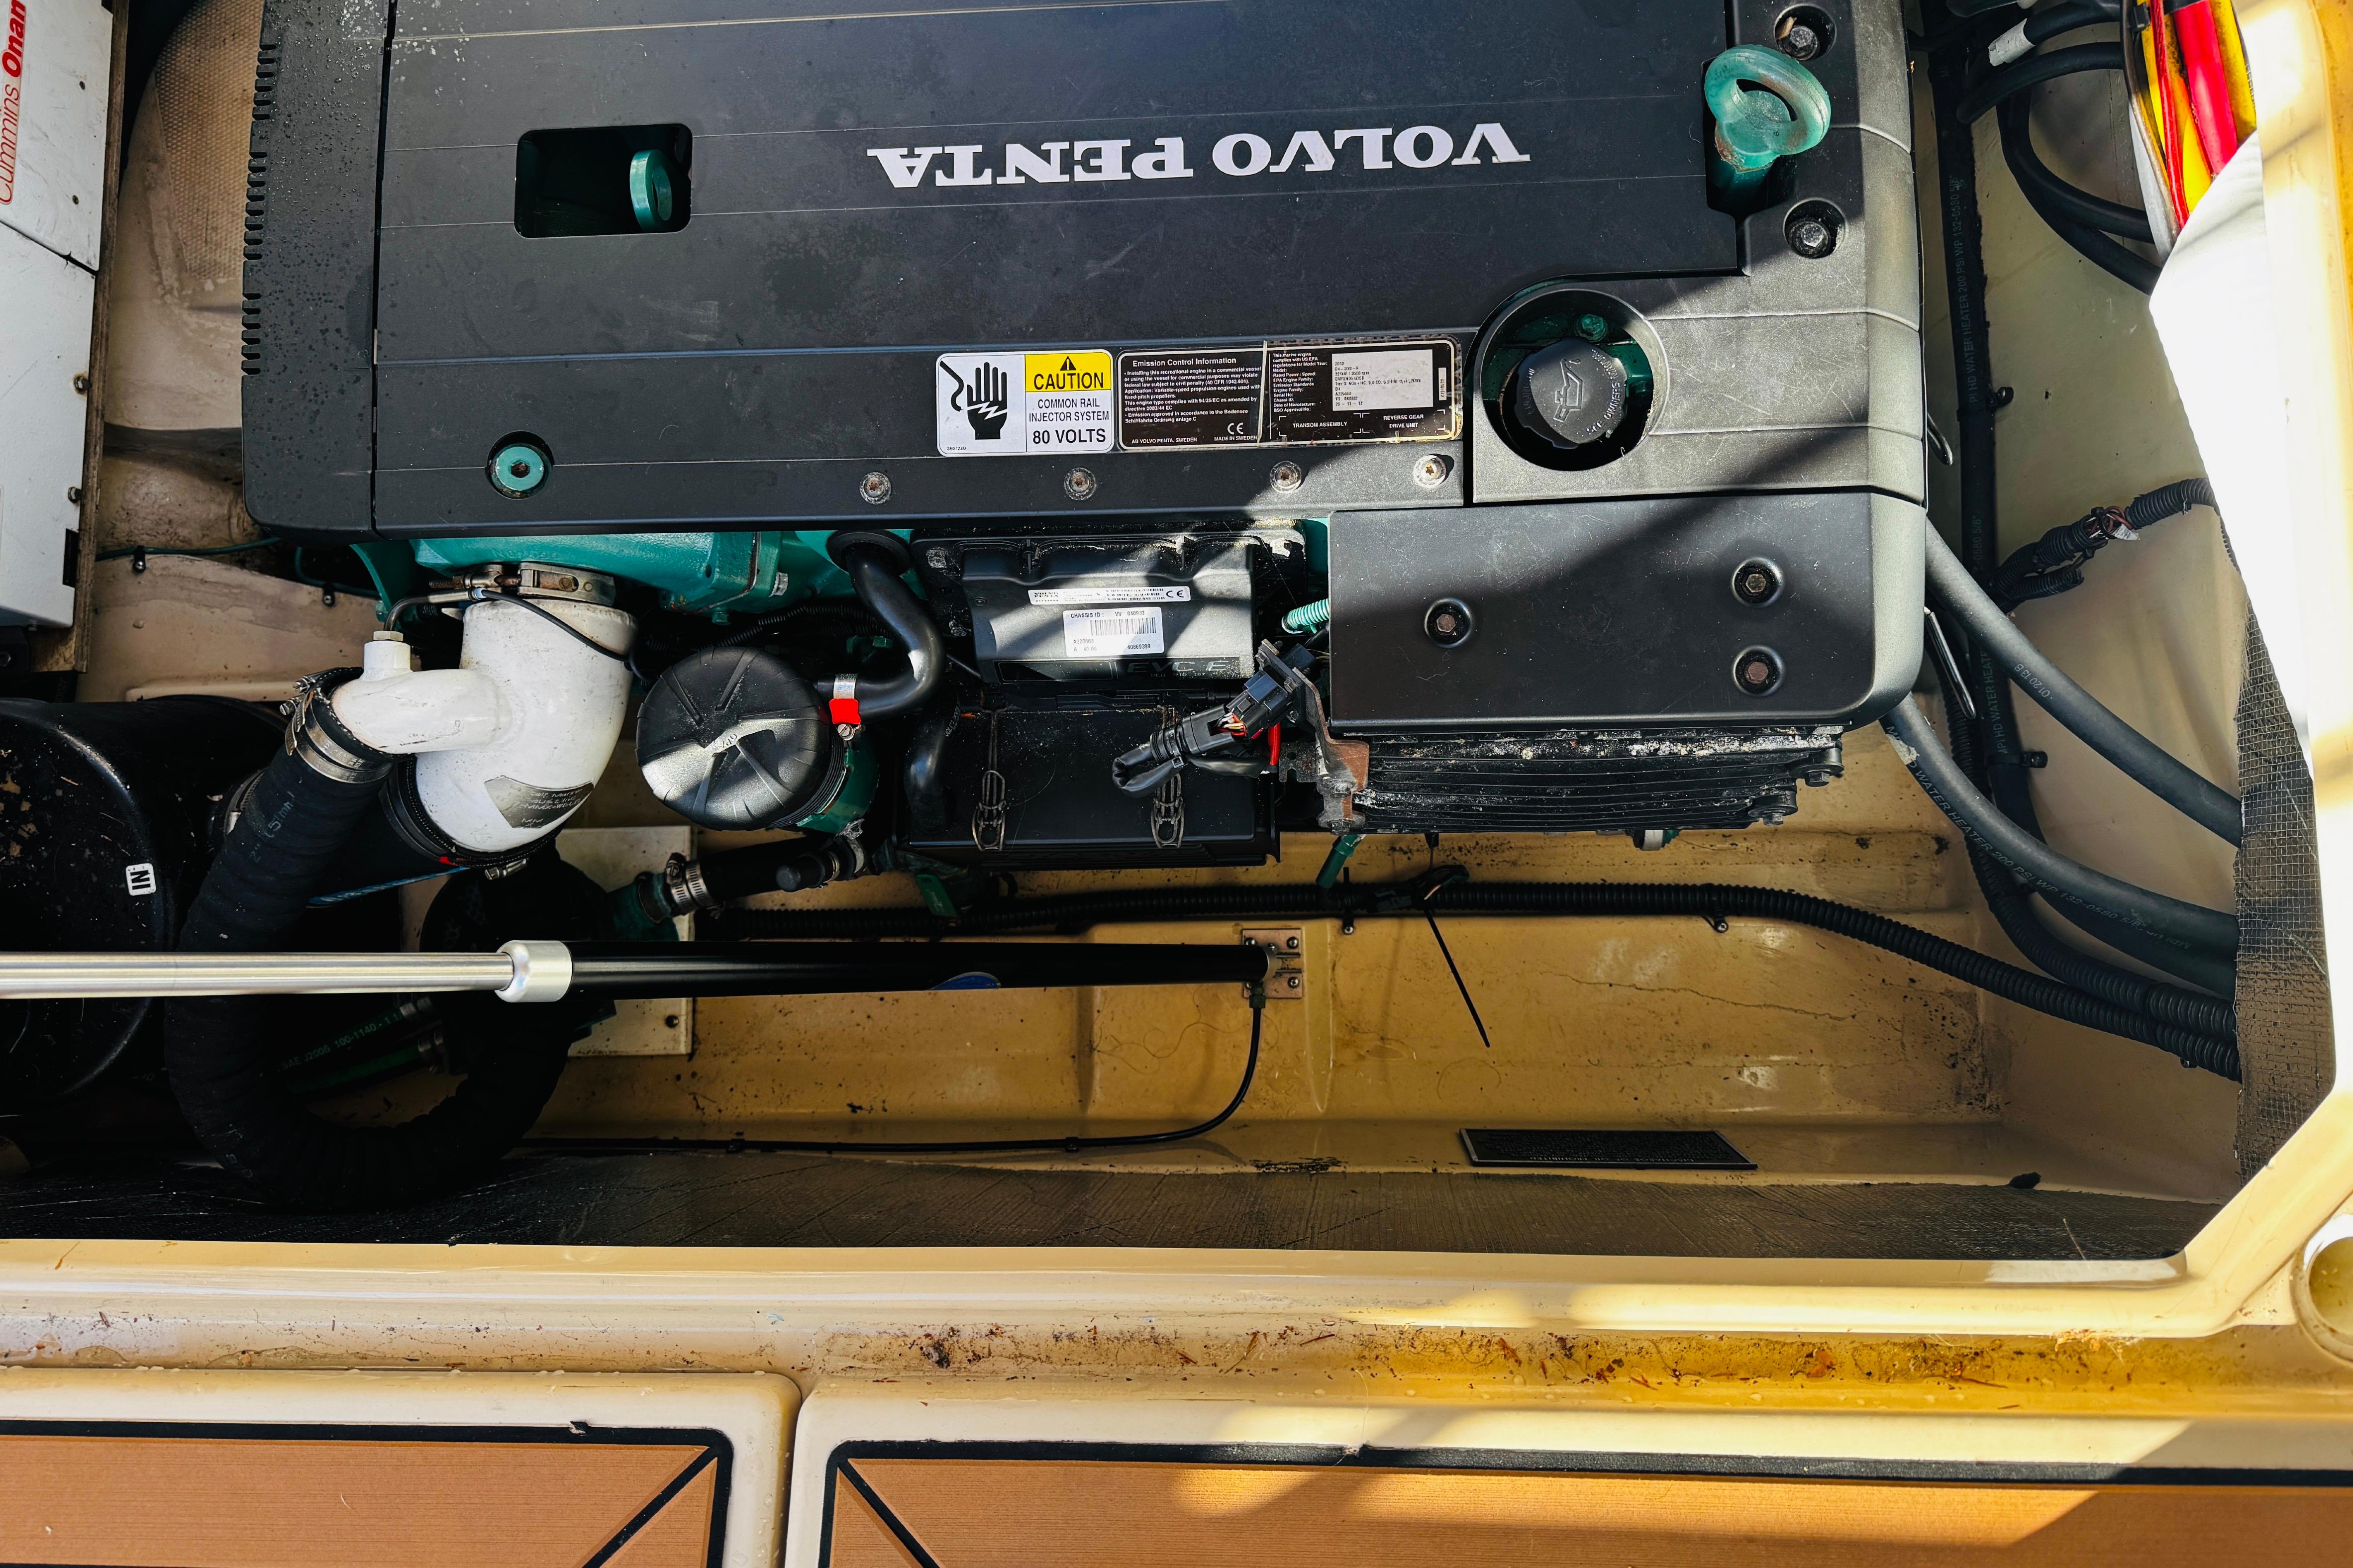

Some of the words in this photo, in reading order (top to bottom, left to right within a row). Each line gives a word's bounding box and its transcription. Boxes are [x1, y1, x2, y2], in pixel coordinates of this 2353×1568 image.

[2, 0, 26, 78] Onan
[866, 136, 1194, 188] PENTA
[1212, 123, 1532, 177] VOLVO
[1958, 276, 1967, 293] 200
[1959, 294, 1971, 335] HEATER
[1964, 338, 1976, 374] WATER
[1033, 372, 1104, 390] CAUTION
[1029, 412, 1071, 422] INJECTOR
[1074, 411, 1109, 421] SYSTEM
[1037, 399, 1077, 408] COMMON
[1080, 398, 1100, 408] RAIL
[1032, 430, 1050, 444] 80
[1055, 428, 1106, 443] VOLTS
[1988, 686, 2000, 721] WATER
[1915, 770, 1950, 810] WATER
[1947, 812, 1993, 851] HEATER
[1992, 852, 2014, 866] 200
[2013, 866, 2036, 880] PSI
[2037, 880, 2058, 892] WP
[2060, 892, 2118, 919] 132-0580
[130, 870, 151, 890] IN
